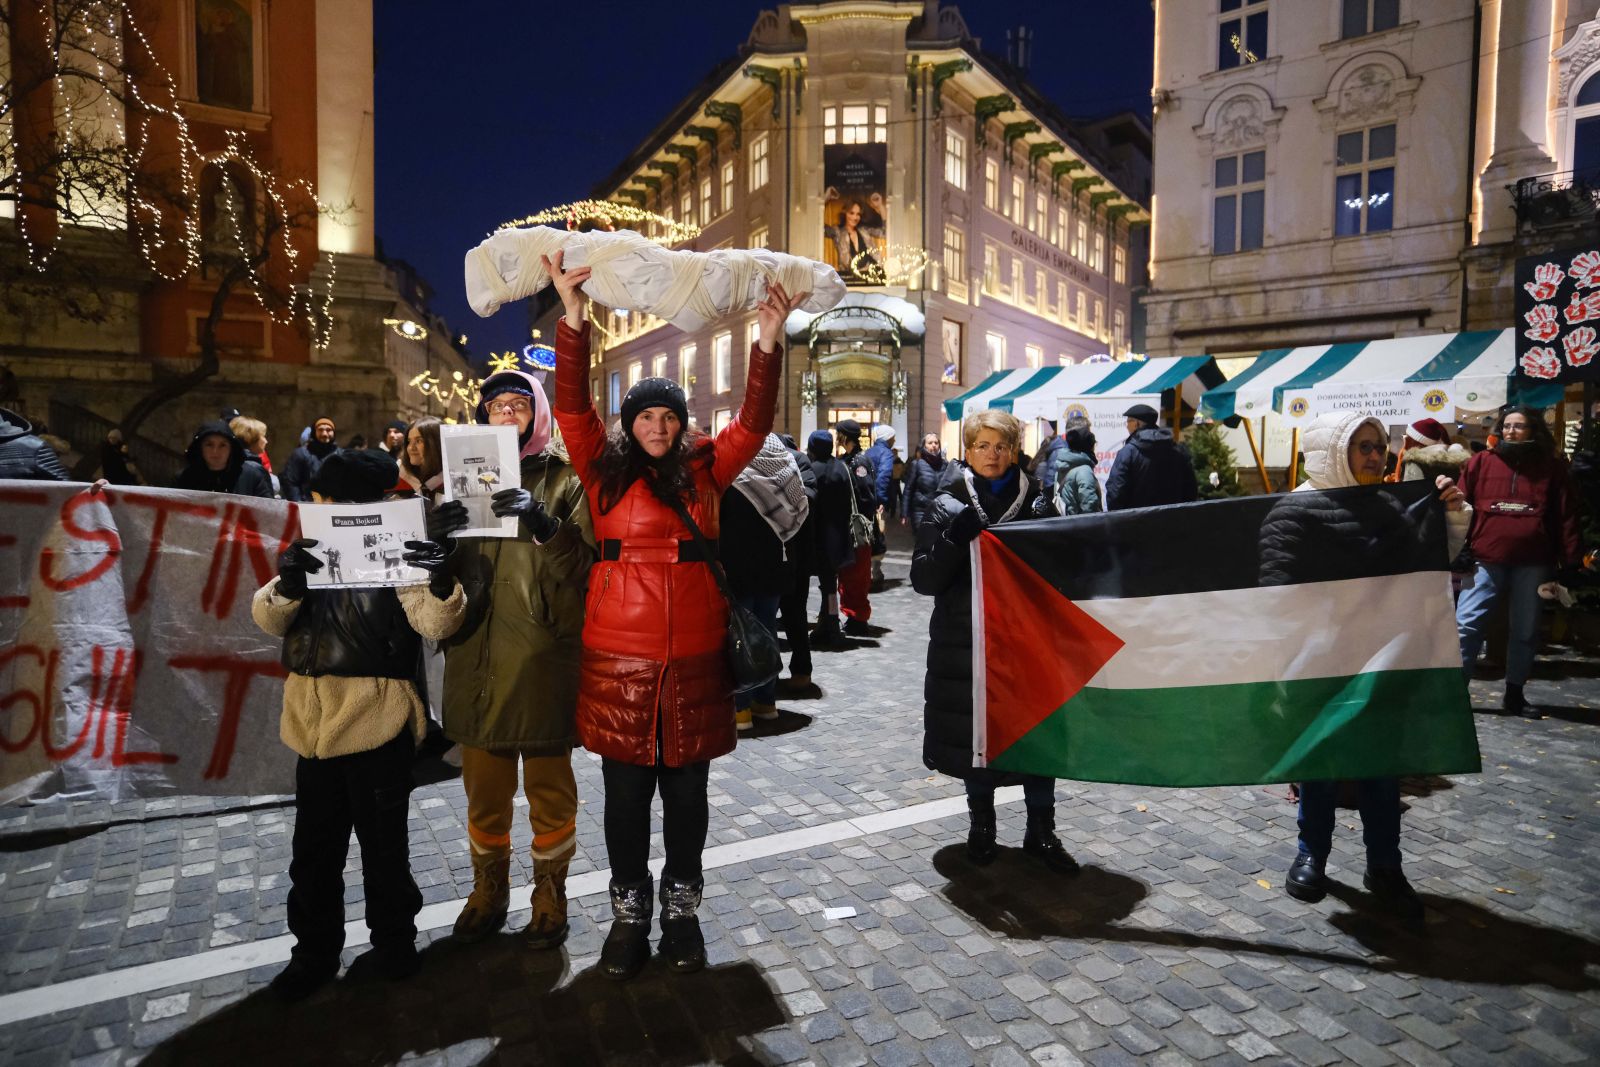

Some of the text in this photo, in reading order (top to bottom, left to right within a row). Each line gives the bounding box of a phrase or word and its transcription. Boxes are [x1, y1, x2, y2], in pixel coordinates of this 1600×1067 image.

[1011, 230, 1090, 282] GALERIJA EMPORIUM
[1317, 390, 1412, 401] DOBRODELNA STOJNICA
[1333, 399, 1393, 409] LIONS KLUB
[1375, 408, 1411, 417] BARJE
[1093, 421, 1126, 429] Ljubljan
[355, 517, 379, 525] Bojkot!
